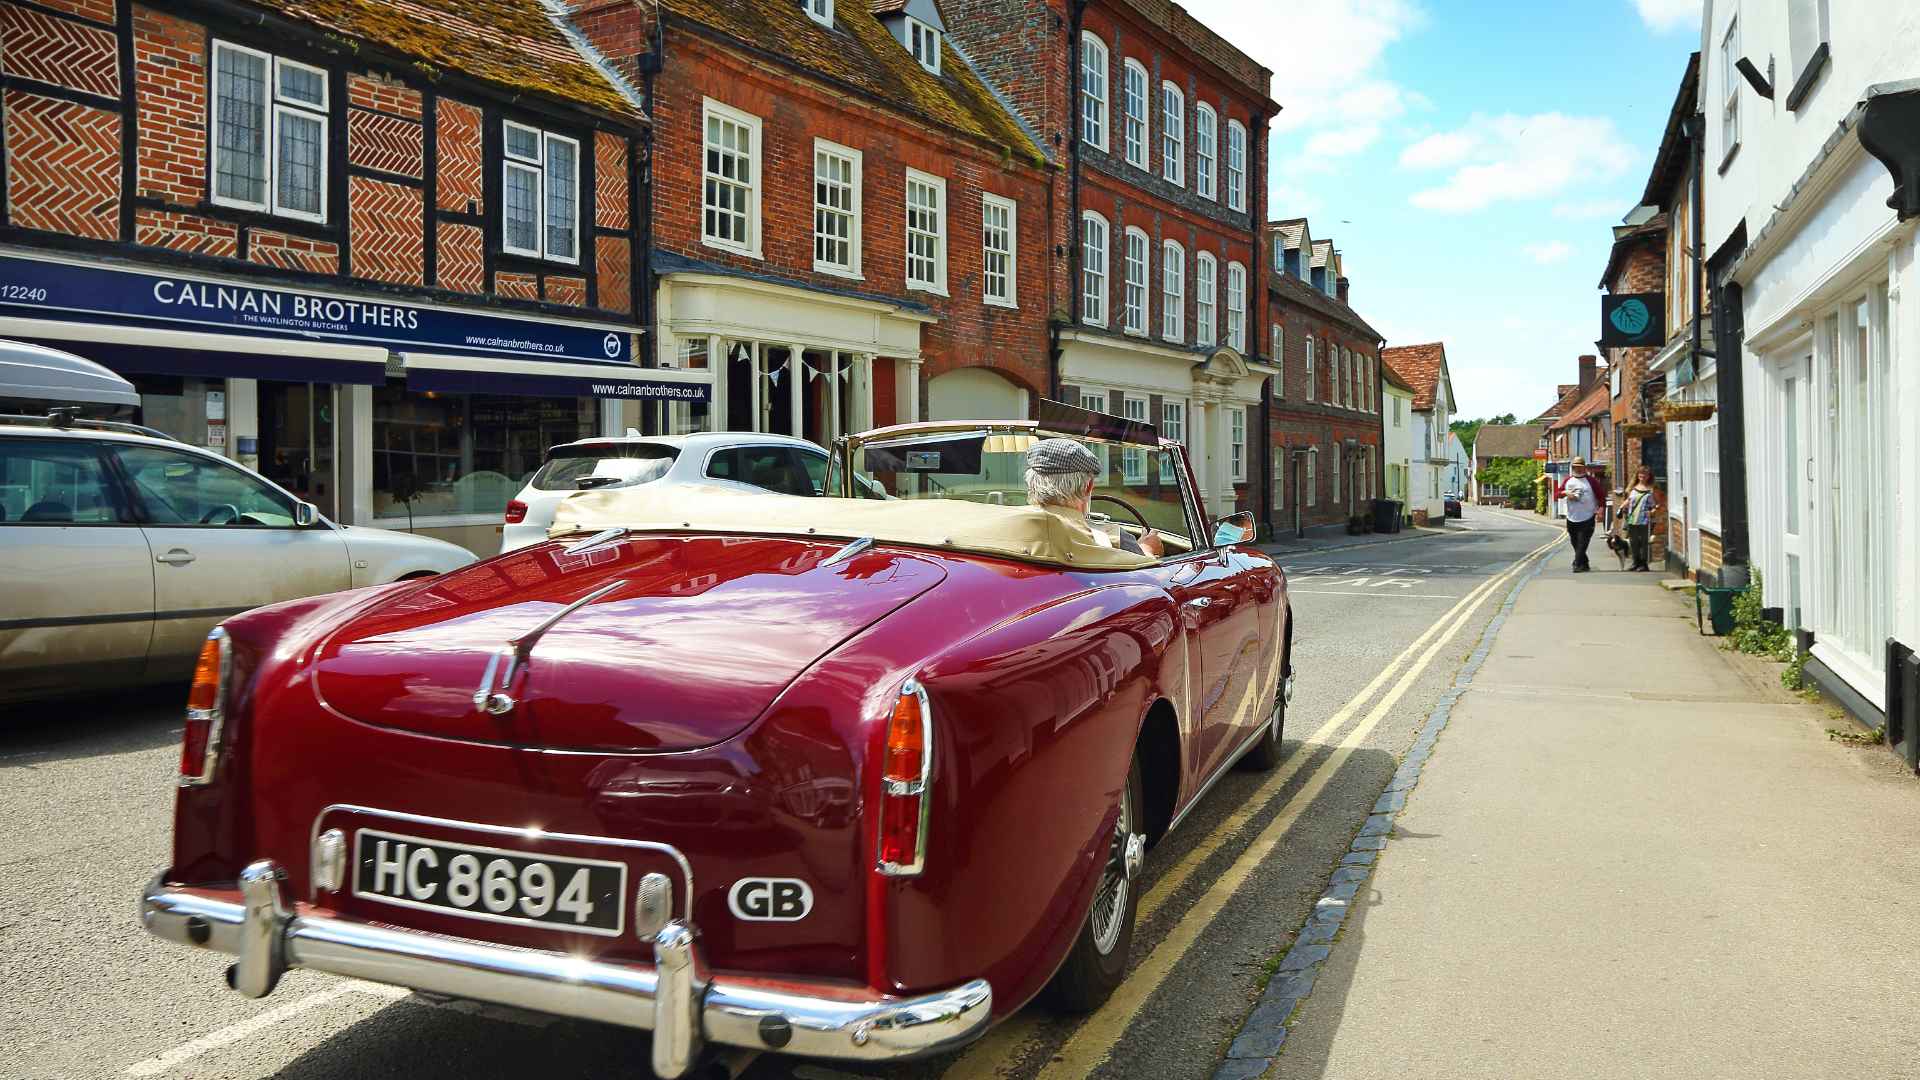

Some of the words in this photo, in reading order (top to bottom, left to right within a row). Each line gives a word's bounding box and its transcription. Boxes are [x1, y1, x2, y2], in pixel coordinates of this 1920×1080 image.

[1, 285, 47, 301] 12240
[153, 280, 281, 315] CALNAN
[294, 295, 418, 329] BROTHERS
[243, 314, 258, 323] THE
[259, 316, 310, 327] WATLINGTON
[312, 321, 348, 331] BUTCHERS
[465, 335, 565, 353] www.calnanbrothers.co.uk
[592, 383, 705, 398] www.calnanbrothers.co.uk
[373, 840, 439, 900] HC
[446, 854, 595, 924] 8694
[737, 881, 805, 918] GB
